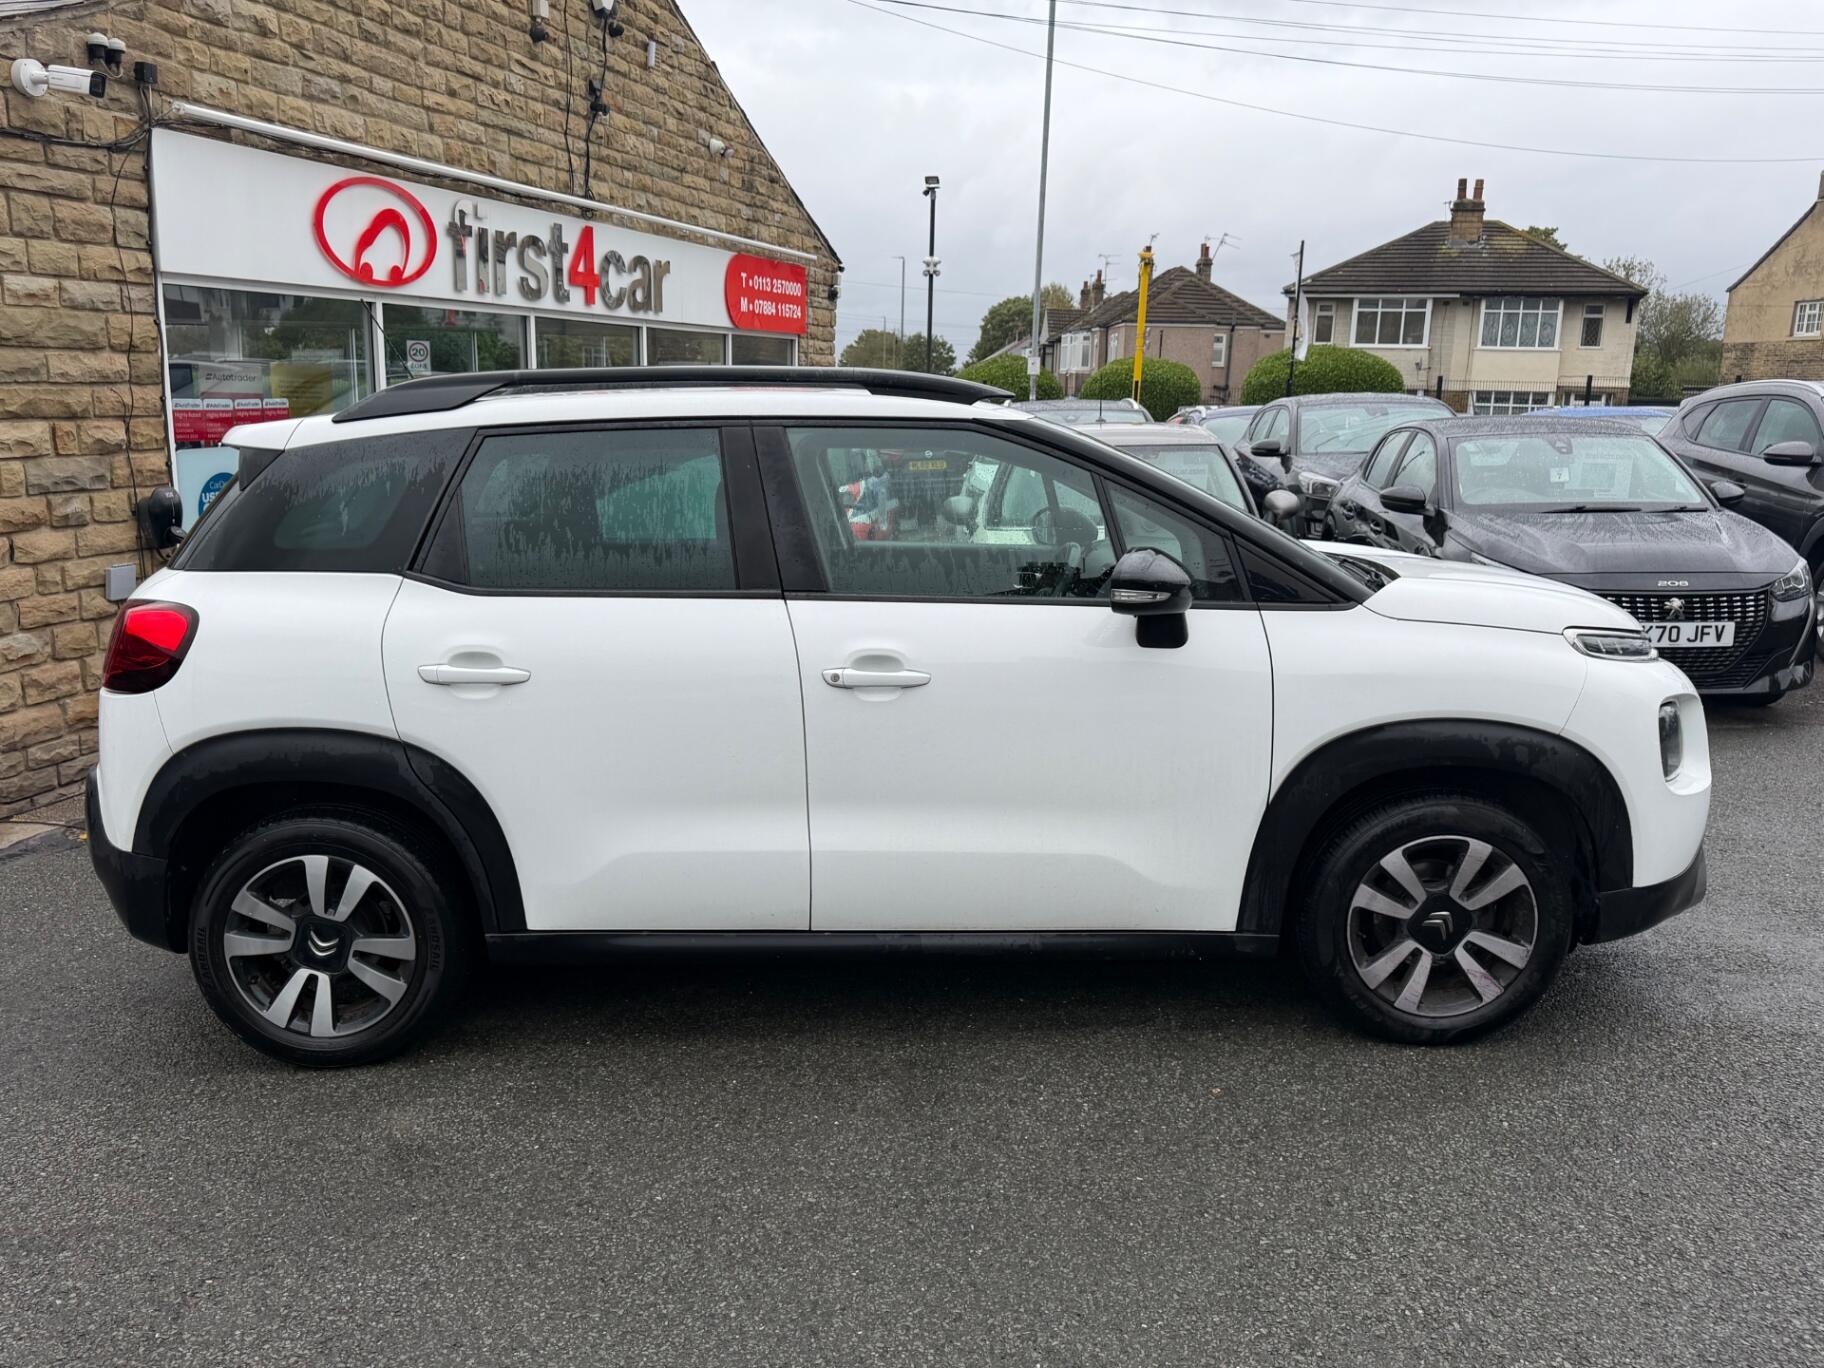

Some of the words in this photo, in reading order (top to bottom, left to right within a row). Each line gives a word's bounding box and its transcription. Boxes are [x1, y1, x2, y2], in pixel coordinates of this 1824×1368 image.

[447, 200, 670, 313] first4car
[741, 272, 747, 288] T
[753, 275, 771, 292] 0113
[772, 278, 802, 297] 2570000
[740, 296, 748, 312] M
[754, 299, 776, 316] 07884
[777, 302, 802, 319] 115724
[412, 348, 425, 357] 20
[1686, 625, 1726, 643] JFV
